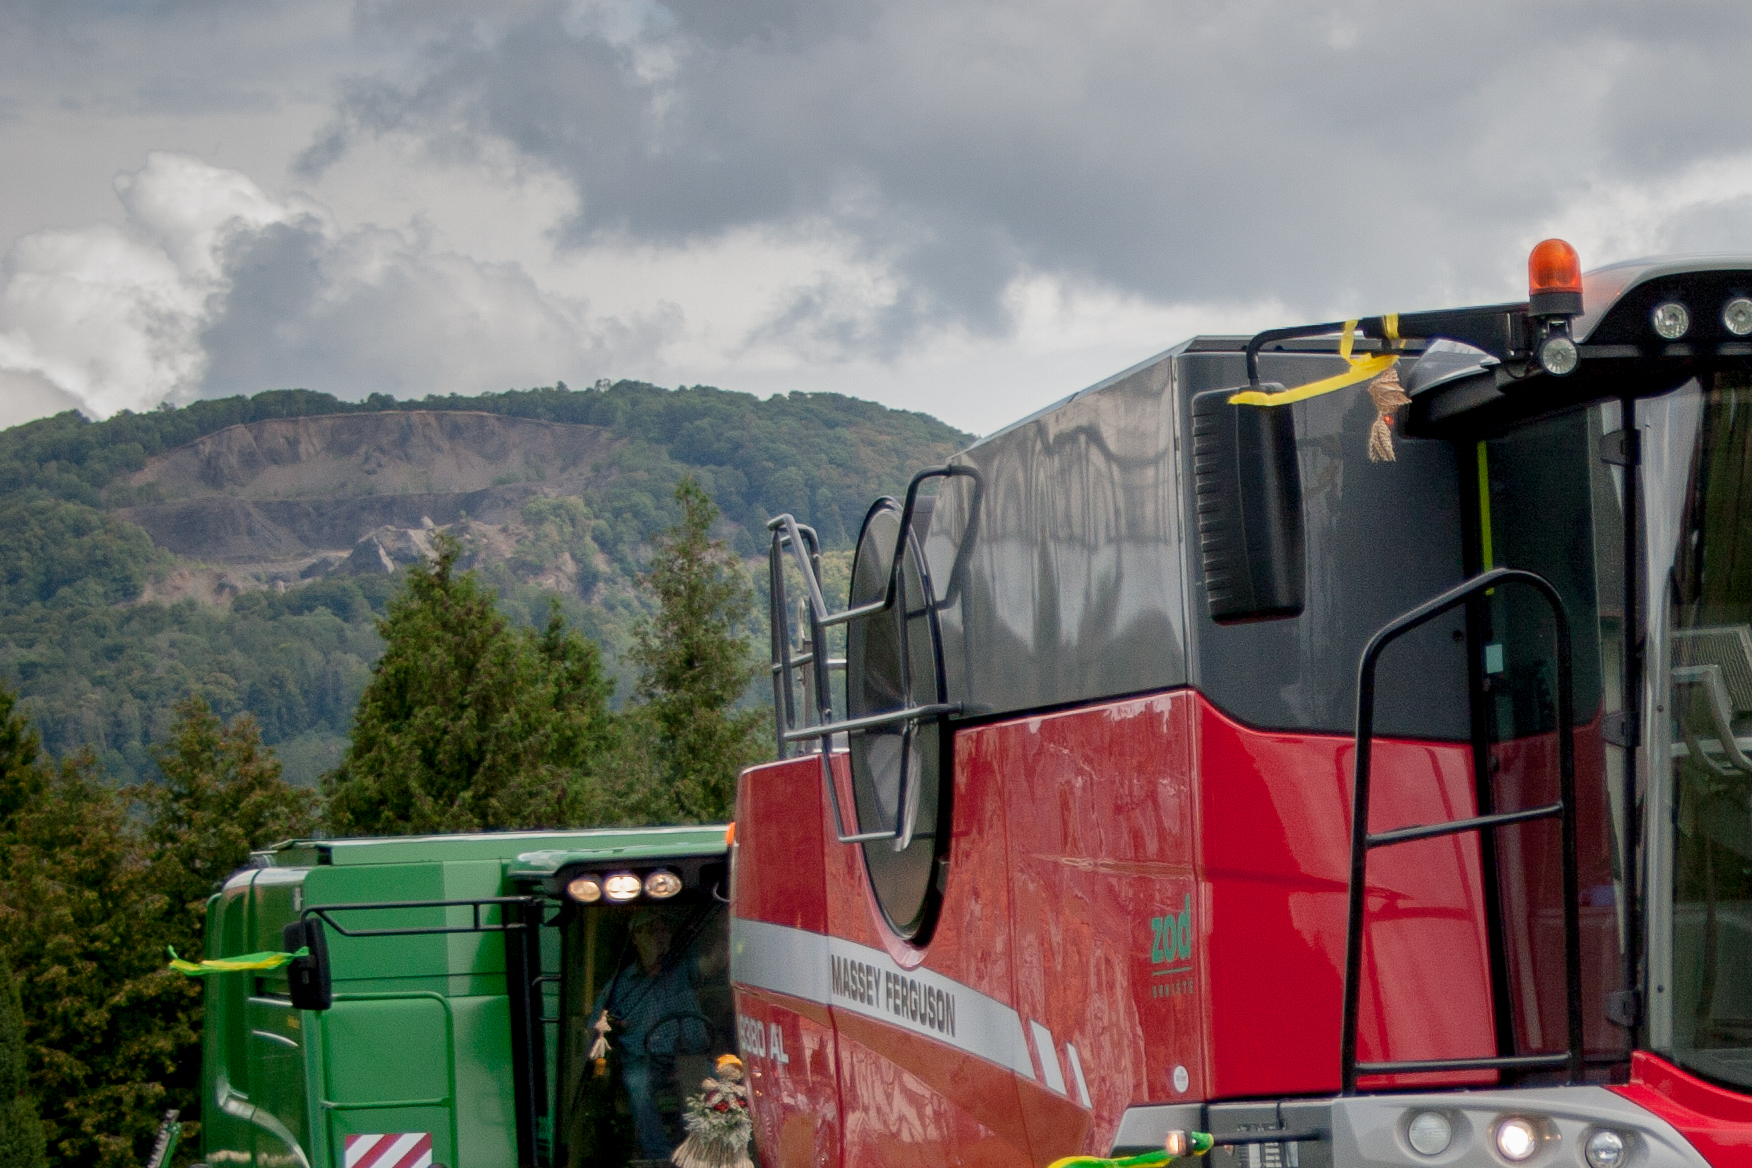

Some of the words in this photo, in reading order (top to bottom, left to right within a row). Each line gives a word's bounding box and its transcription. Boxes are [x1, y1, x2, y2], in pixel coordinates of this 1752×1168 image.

[1151, 893, 1191, 963] zod
[831, 953, 881, 1009] MASSEY
[885, 970, 956, 1038] FERGUSON
[770, 1022, 789, 1063] AL
